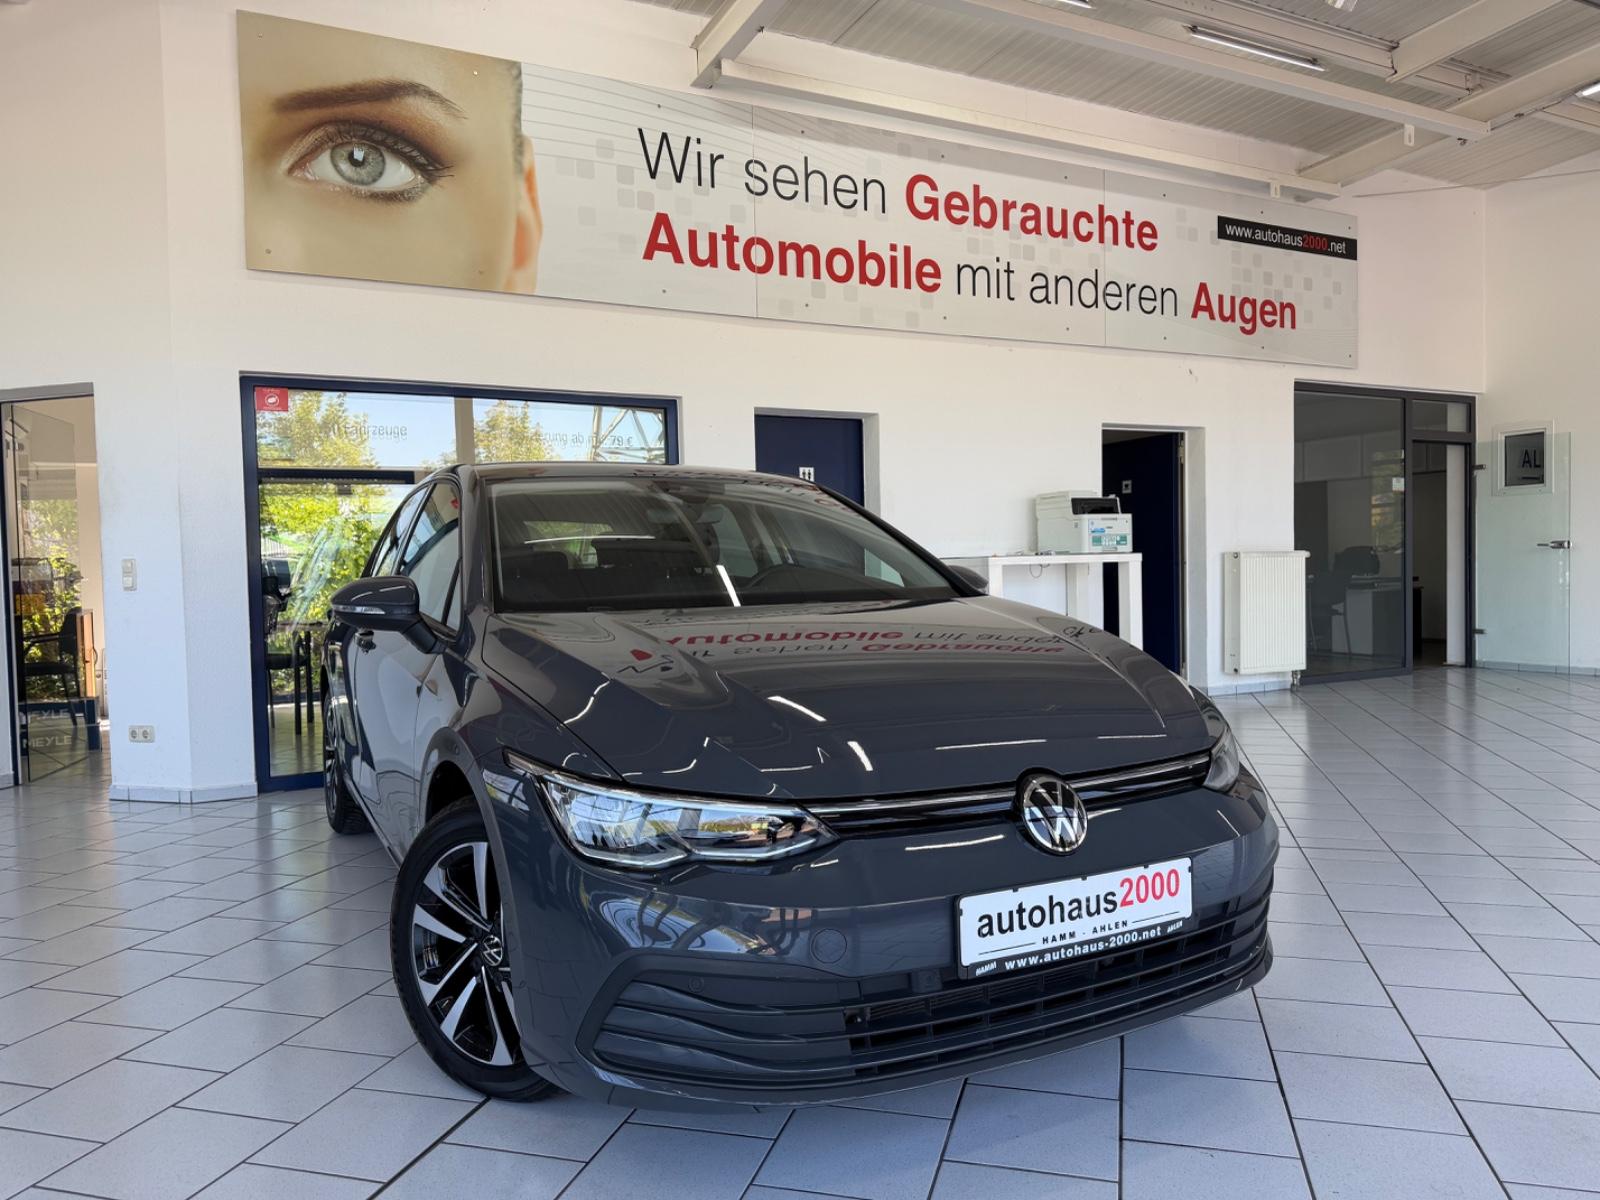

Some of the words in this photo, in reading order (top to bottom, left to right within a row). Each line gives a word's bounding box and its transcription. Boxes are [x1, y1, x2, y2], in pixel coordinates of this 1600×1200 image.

[638, 128, 724, 188] Wir
[744, 156, 886, 213] sehen
[905, 174, 1158, 251] Gebrauchte
[642, 212, 942, 293] Automobile
[957, 256, 1015, 301] mit
[1029, 269, 1178, 316] anderen
[1190, 282, 1297, 335] Augen
[1225, 224, 1346, 254] www.autohaus2000.net
[977, 868, 1180, 938] autohaus2000
[1042, 931, 1076, 945] HAMM
[1092, 920, 1128, 934] AHLEN
